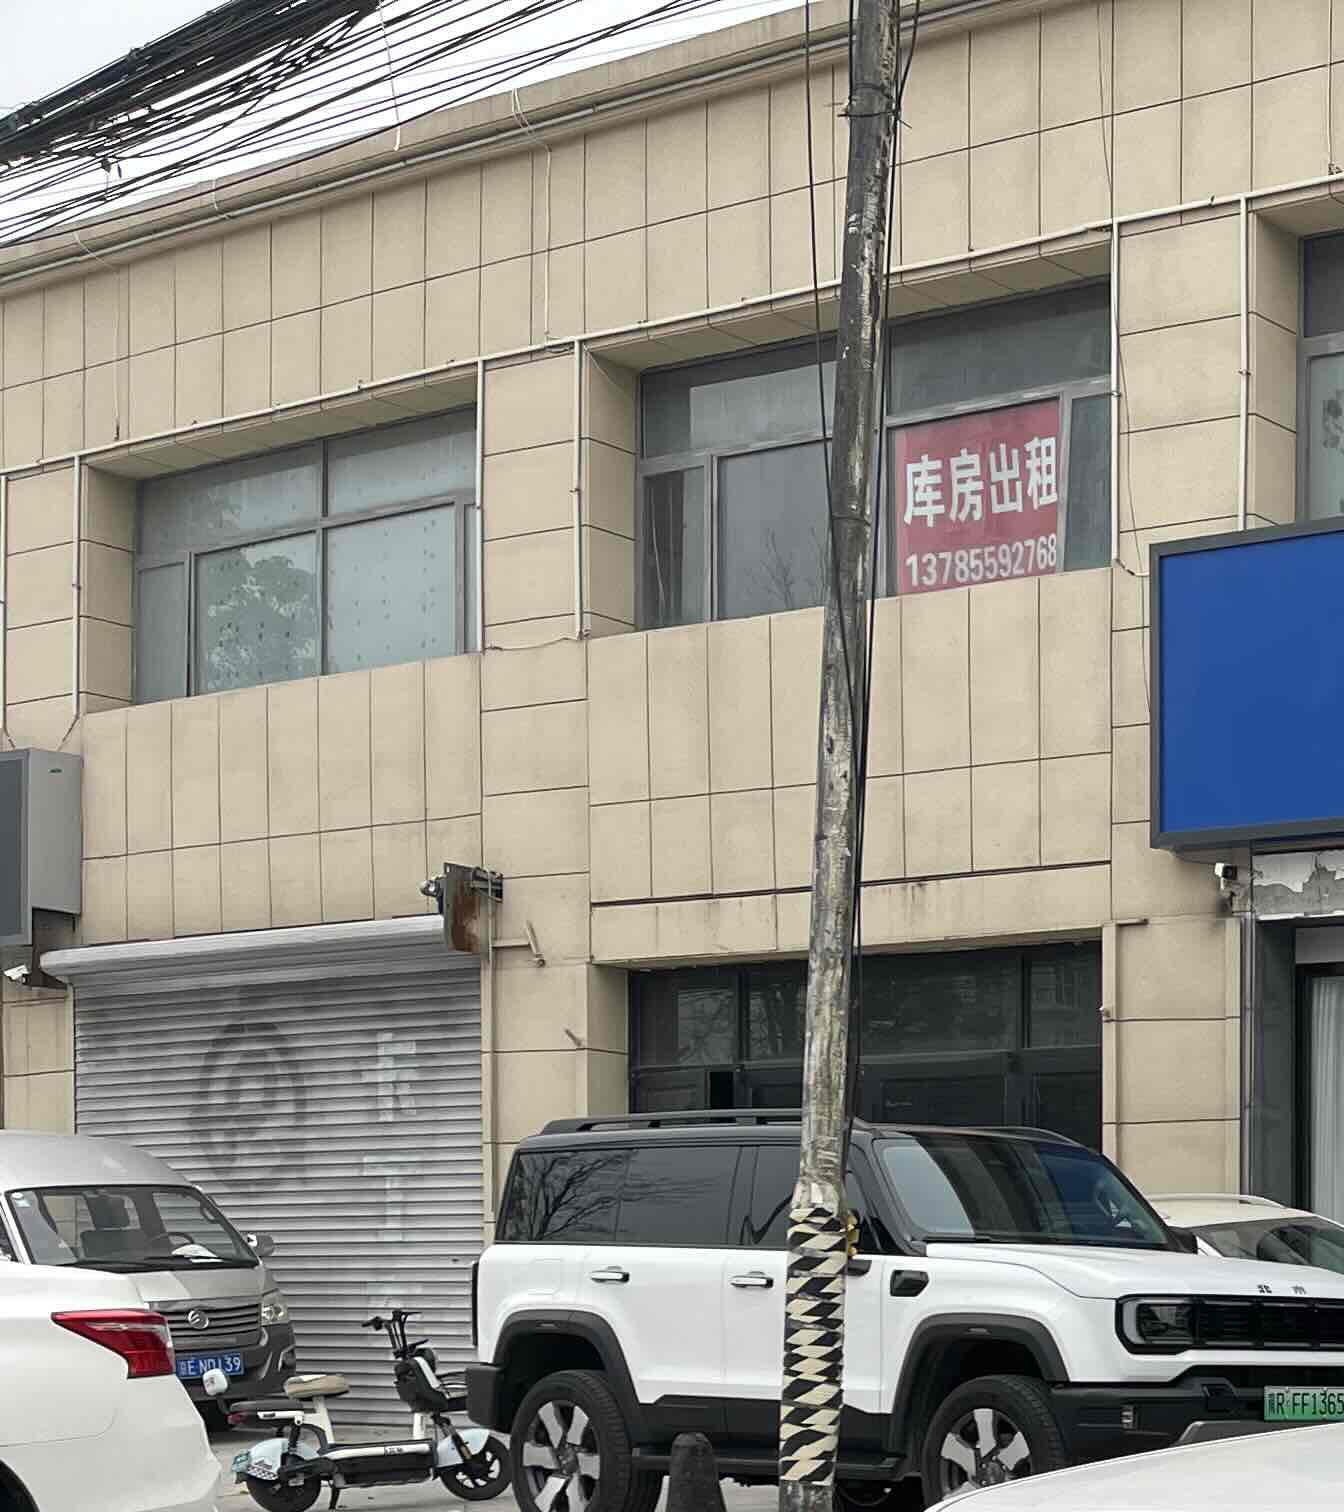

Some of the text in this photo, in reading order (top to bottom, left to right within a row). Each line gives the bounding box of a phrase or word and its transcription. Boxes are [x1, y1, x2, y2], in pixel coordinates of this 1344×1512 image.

[904, 436, 1058, 528] 库房出租
[906, 533, 1057, 587] 13785592768
